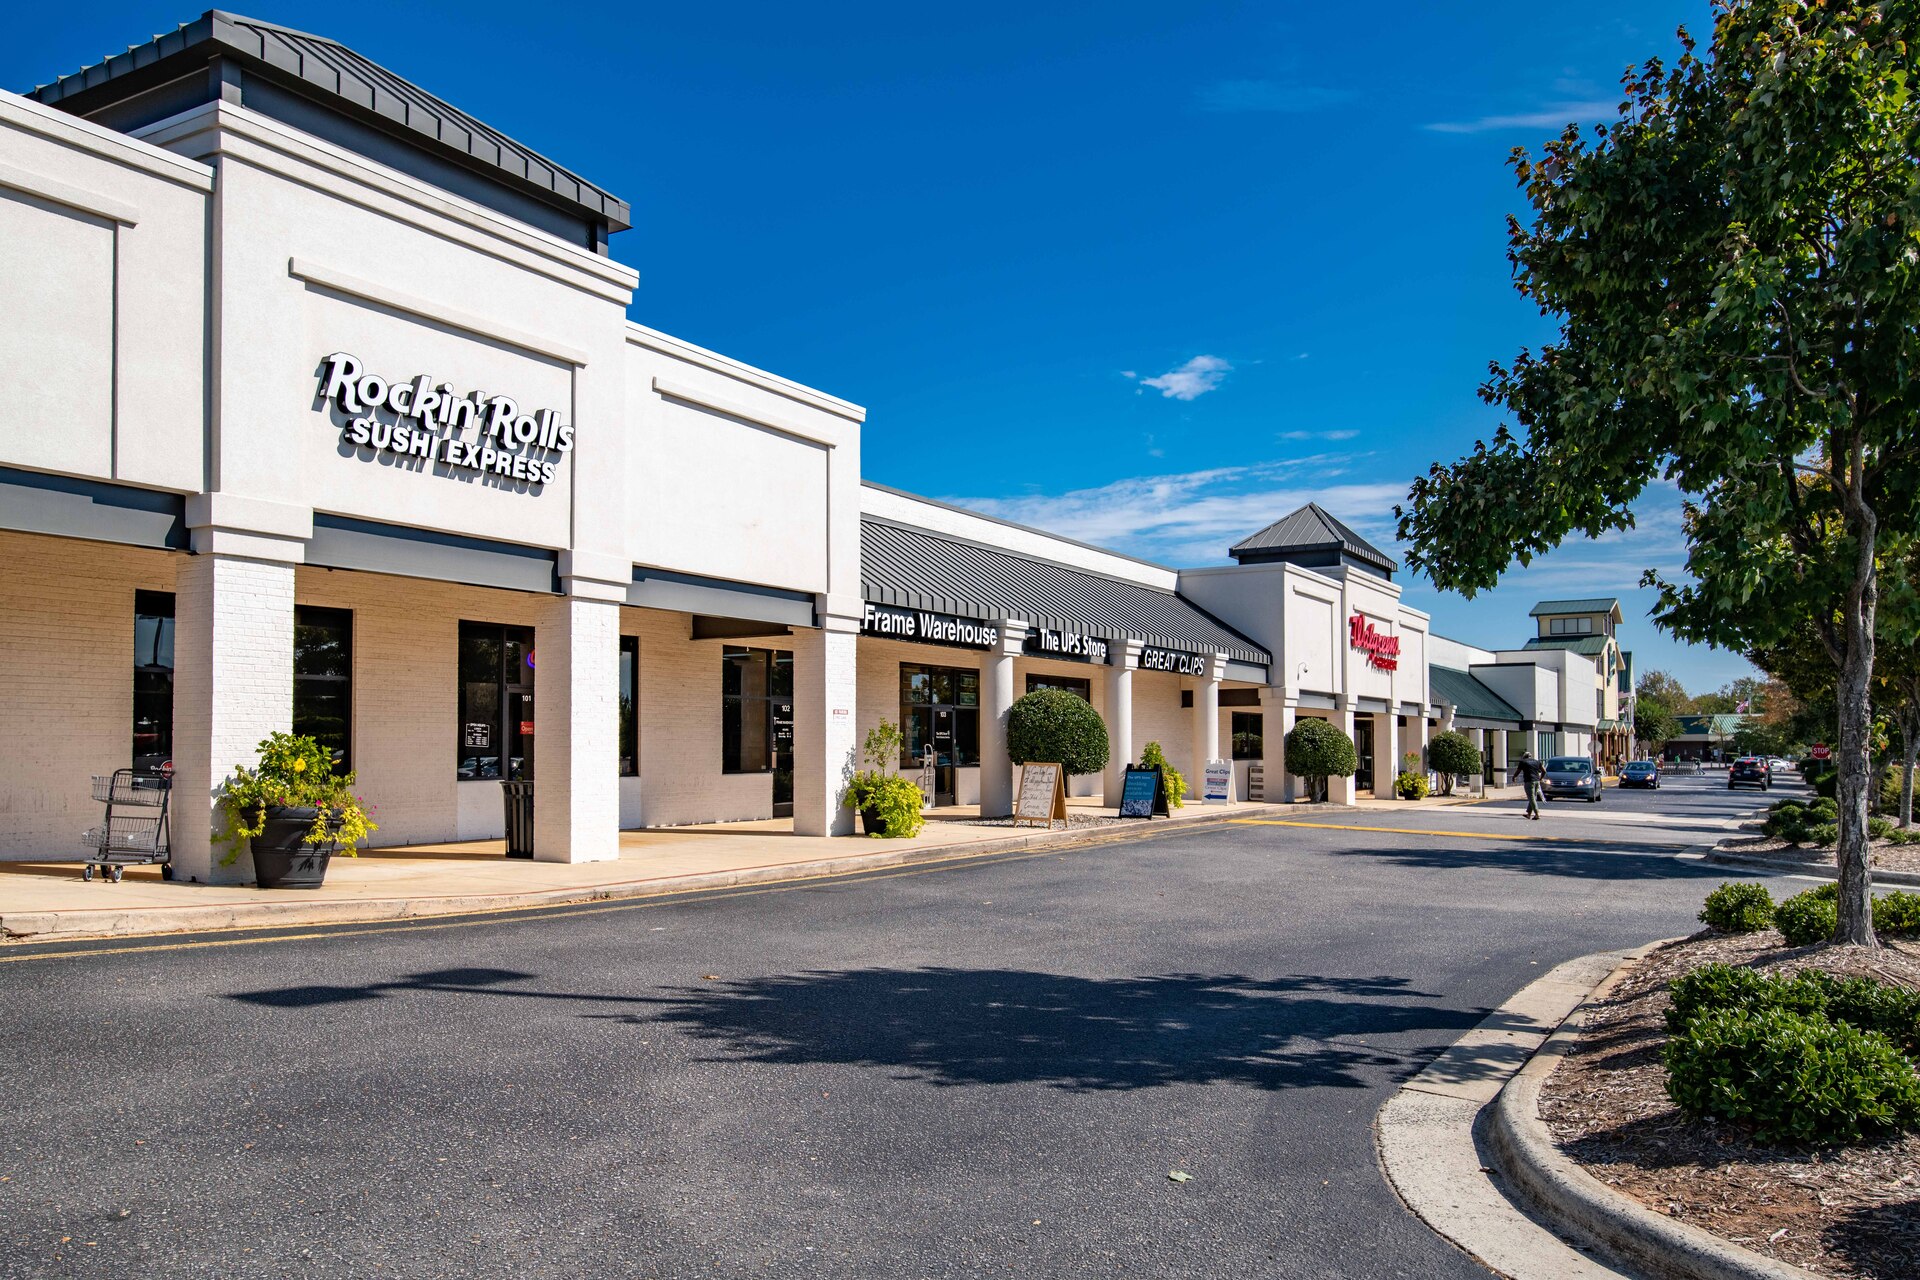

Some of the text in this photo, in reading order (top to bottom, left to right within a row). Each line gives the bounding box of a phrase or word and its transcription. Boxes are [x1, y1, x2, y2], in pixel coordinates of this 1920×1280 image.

[485, 394, 575, 453] Rolls
[350, 417, 556, 485] SUSHI EXPRESS
[864, 604, 998, 646] Frame Warehouse
[1040, 628, 1107, 658] The UPS Store
[1144, 649, 1205, 676] GREAT CLIPS
[781, 704, 791, 713] 102
[1813, 747, 1829, 755] STOP
